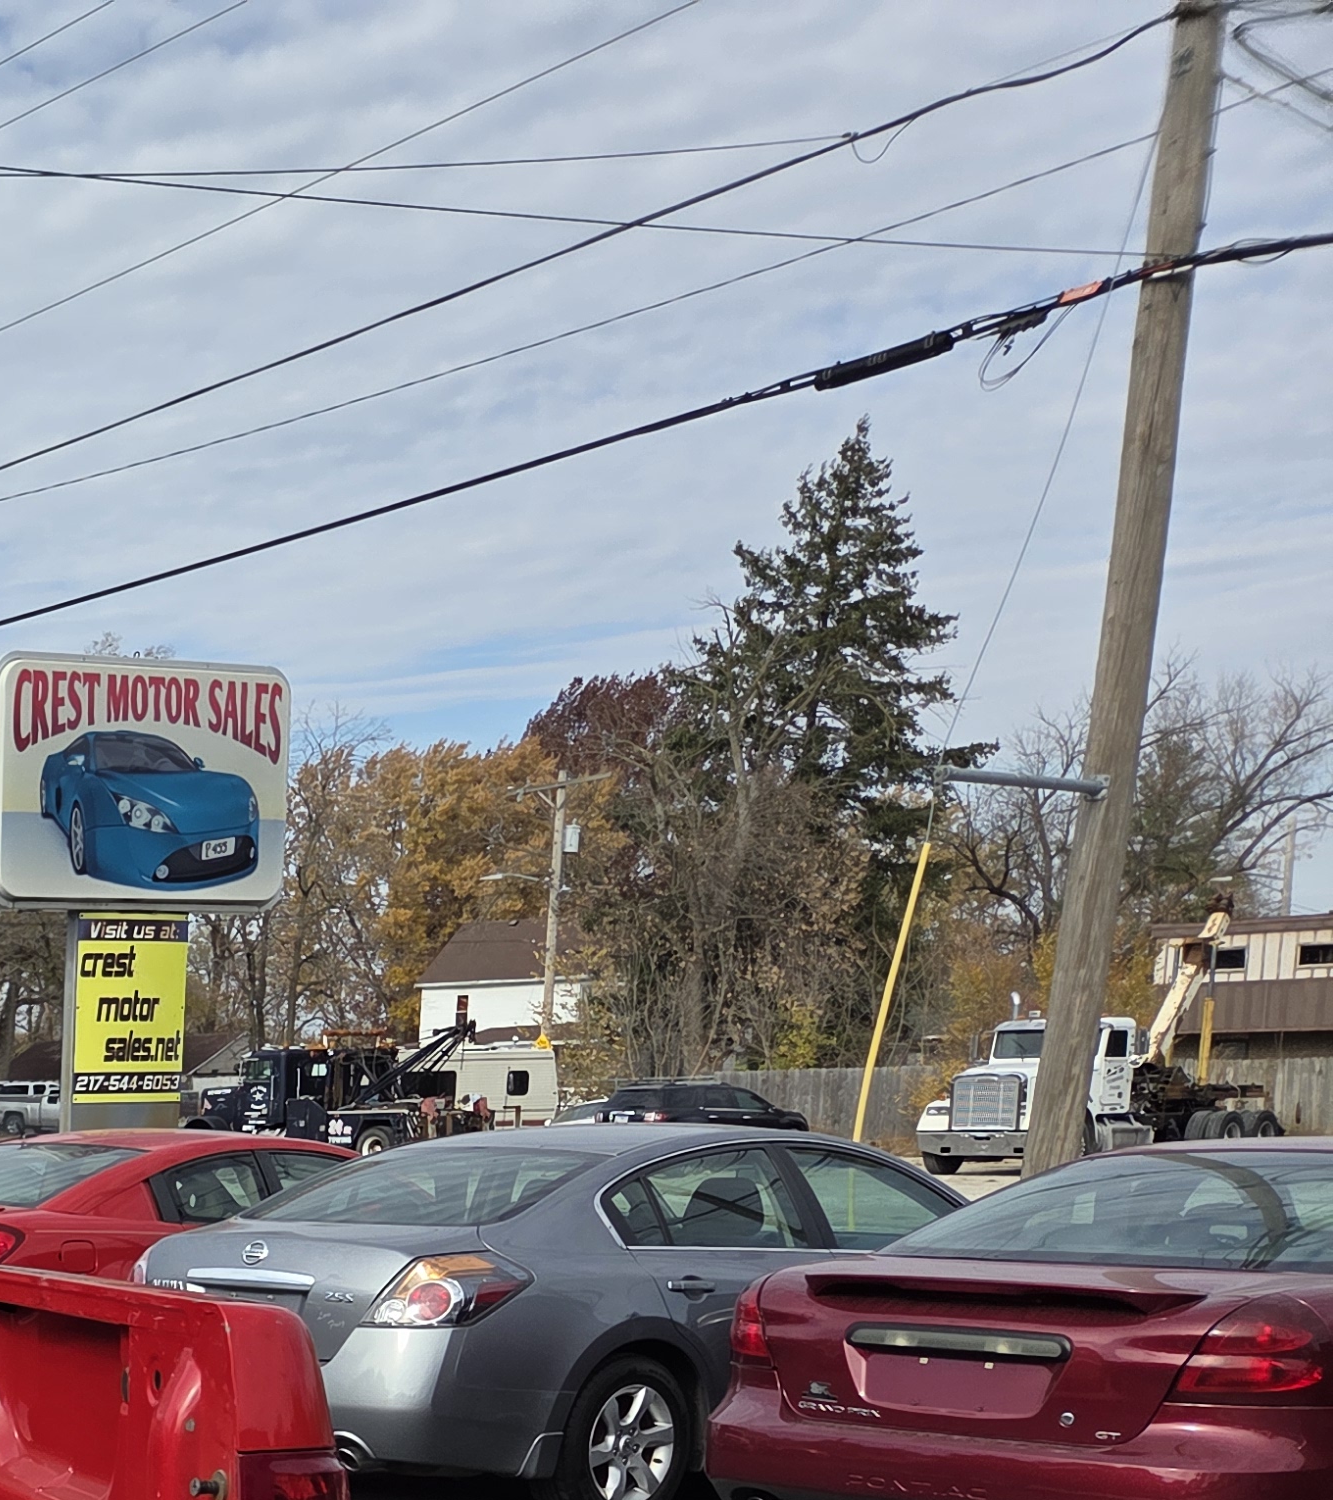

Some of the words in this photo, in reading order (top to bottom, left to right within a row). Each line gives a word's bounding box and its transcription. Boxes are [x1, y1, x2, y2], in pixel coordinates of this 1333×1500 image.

[13, 669, 101, 752] CREST
[107, 674, 201, 728] MOTOR
[207, 679, 282, 765] SALES
[90, 921, 128, 939] Visit
[132, 925, 156, 939] us
[159, 922, 180, 939] at:
[80, 945, 136, 978] crest
[96, 990, 160, 1022] motor
[103, 1030, 181, 1062] sales.net
[74, 1075, 180, 1091] 217-544-6053
[845, 1474, 987, 1500] PONTIAC
